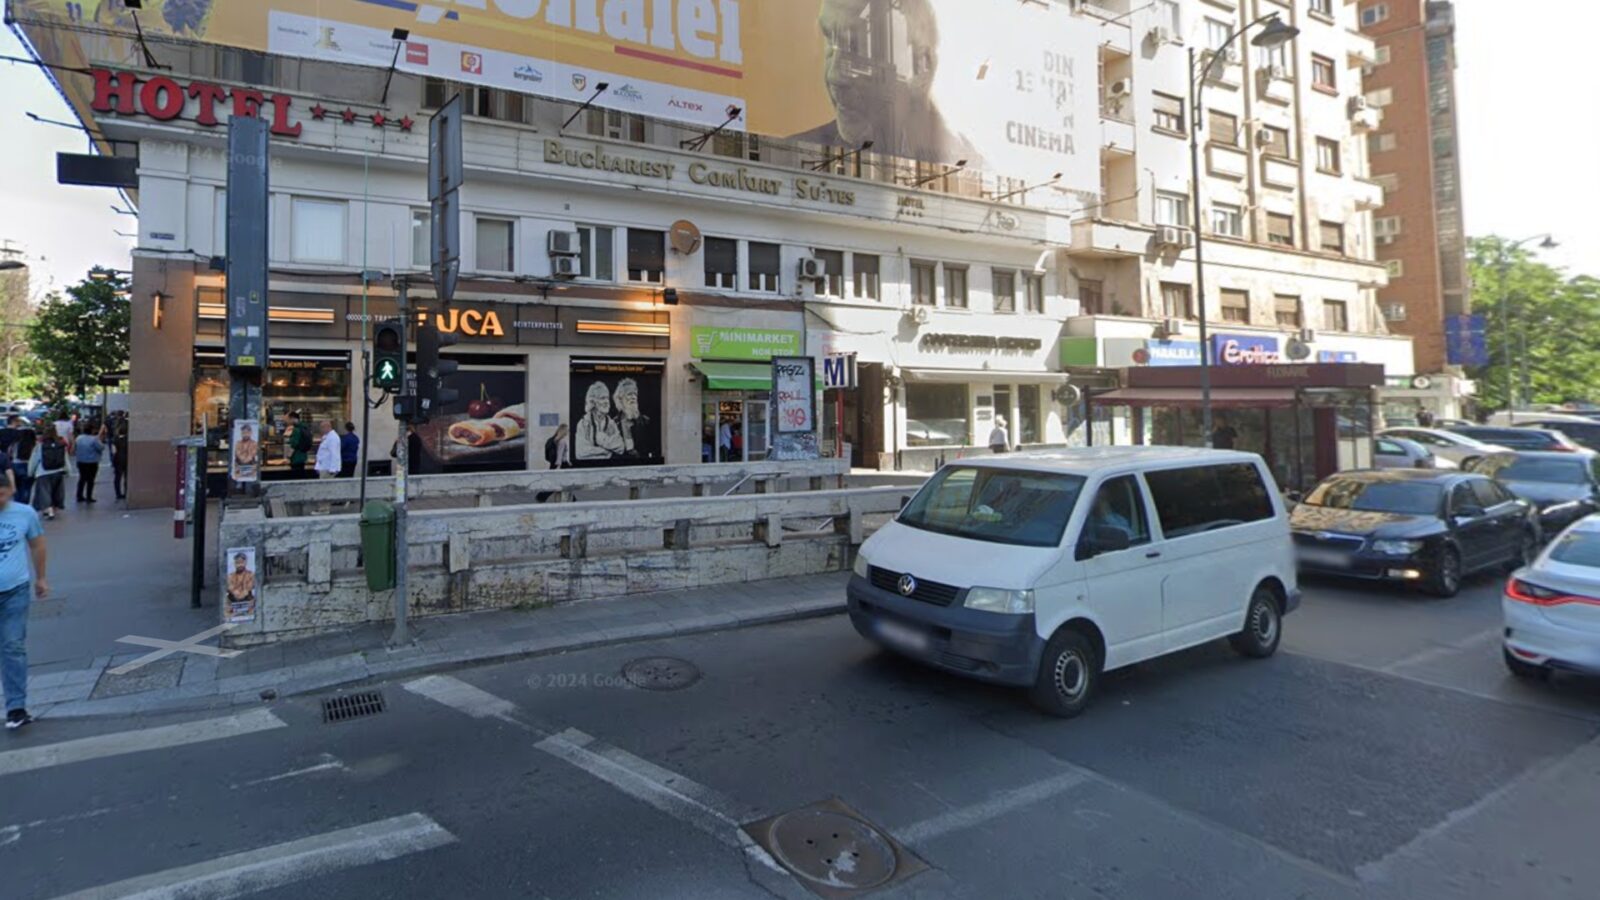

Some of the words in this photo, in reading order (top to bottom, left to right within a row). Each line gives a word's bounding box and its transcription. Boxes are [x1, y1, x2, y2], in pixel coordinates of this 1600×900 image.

[1042, 50, 1075, 79] DIN
[91, 69, 303, 137] HOTEL
[1006, 120, 1076, 156] CINEMA
[720, 331, 795, 344] MINIMARKET
[824, 358, 845, 386] M
